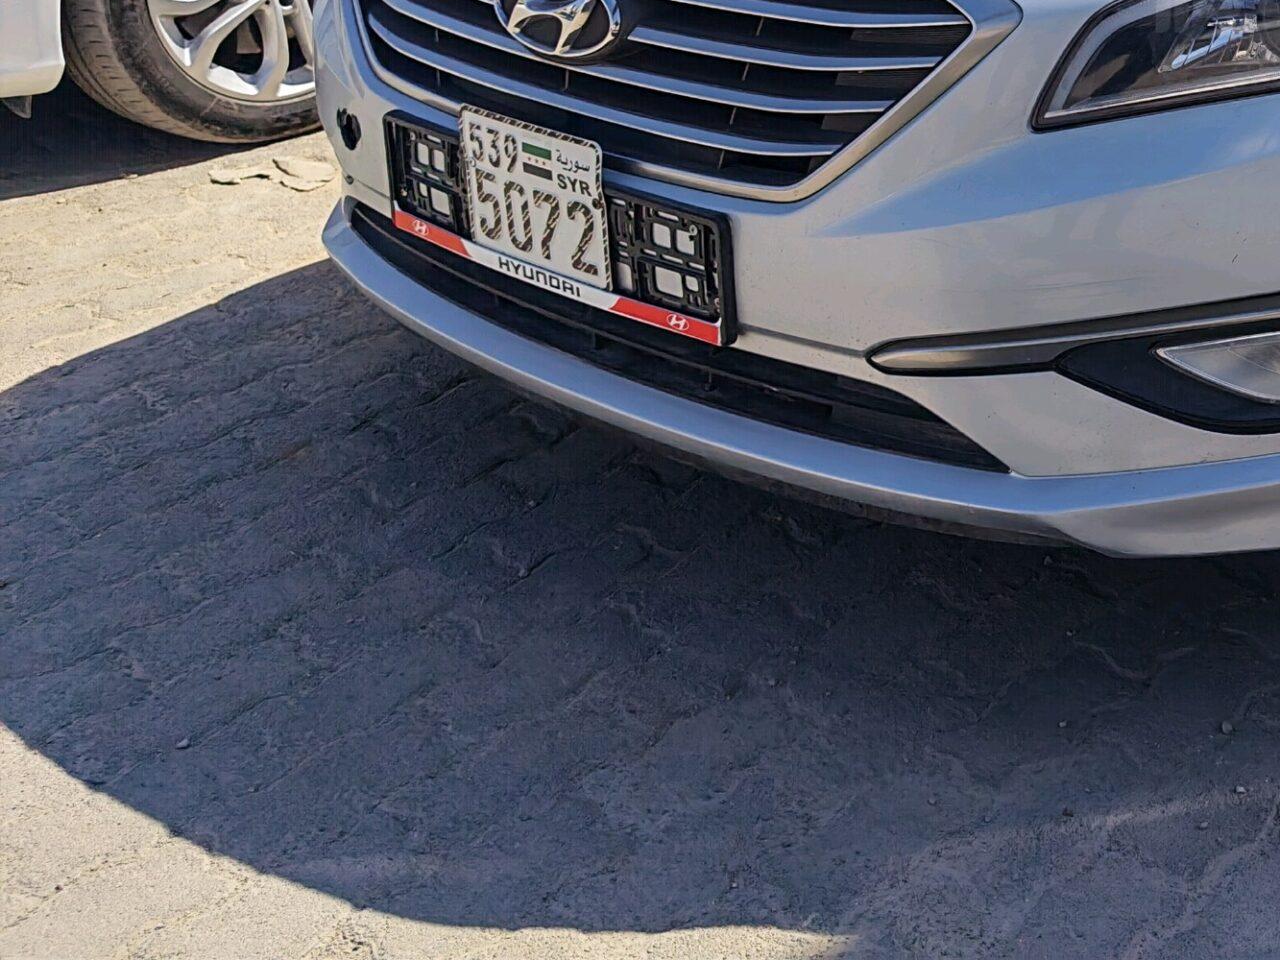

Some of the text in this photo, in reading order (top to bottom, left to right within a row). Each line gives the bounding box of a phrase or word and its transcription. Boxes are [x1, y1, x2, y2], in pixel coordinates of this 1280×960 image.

[469, 122, 518, 173] 539
[555, 149, 590, 173] سورية
[556, 173, 592, 198] SYR
[475, 169, 598, 276] 5072
[498, 256, 582, 297] HYUNDAI
